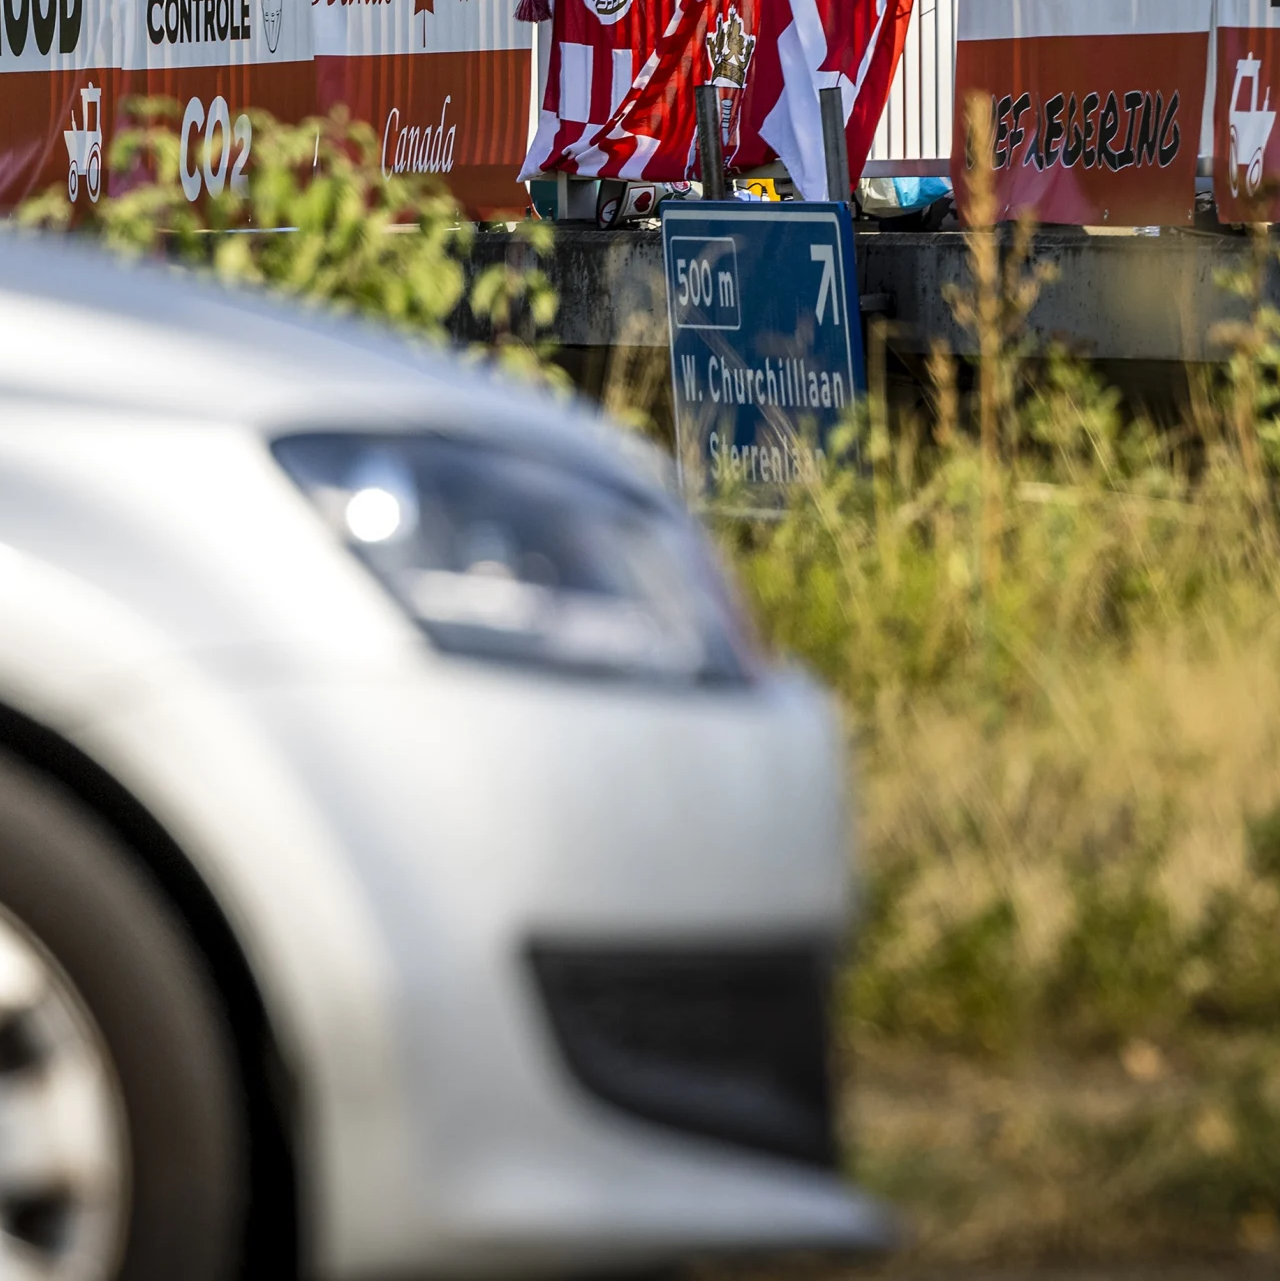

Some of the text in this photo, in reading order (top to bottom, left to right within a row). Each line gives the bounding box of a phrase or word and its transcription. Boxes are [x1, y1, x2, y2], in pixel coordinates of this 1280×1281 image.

[179, 95, 252, 202] CO2
[382, 95, 457, 182] Canada
[677, 259, 734, 307] 500 m
[681, 355, 845, 408] W. Churchilllaan
